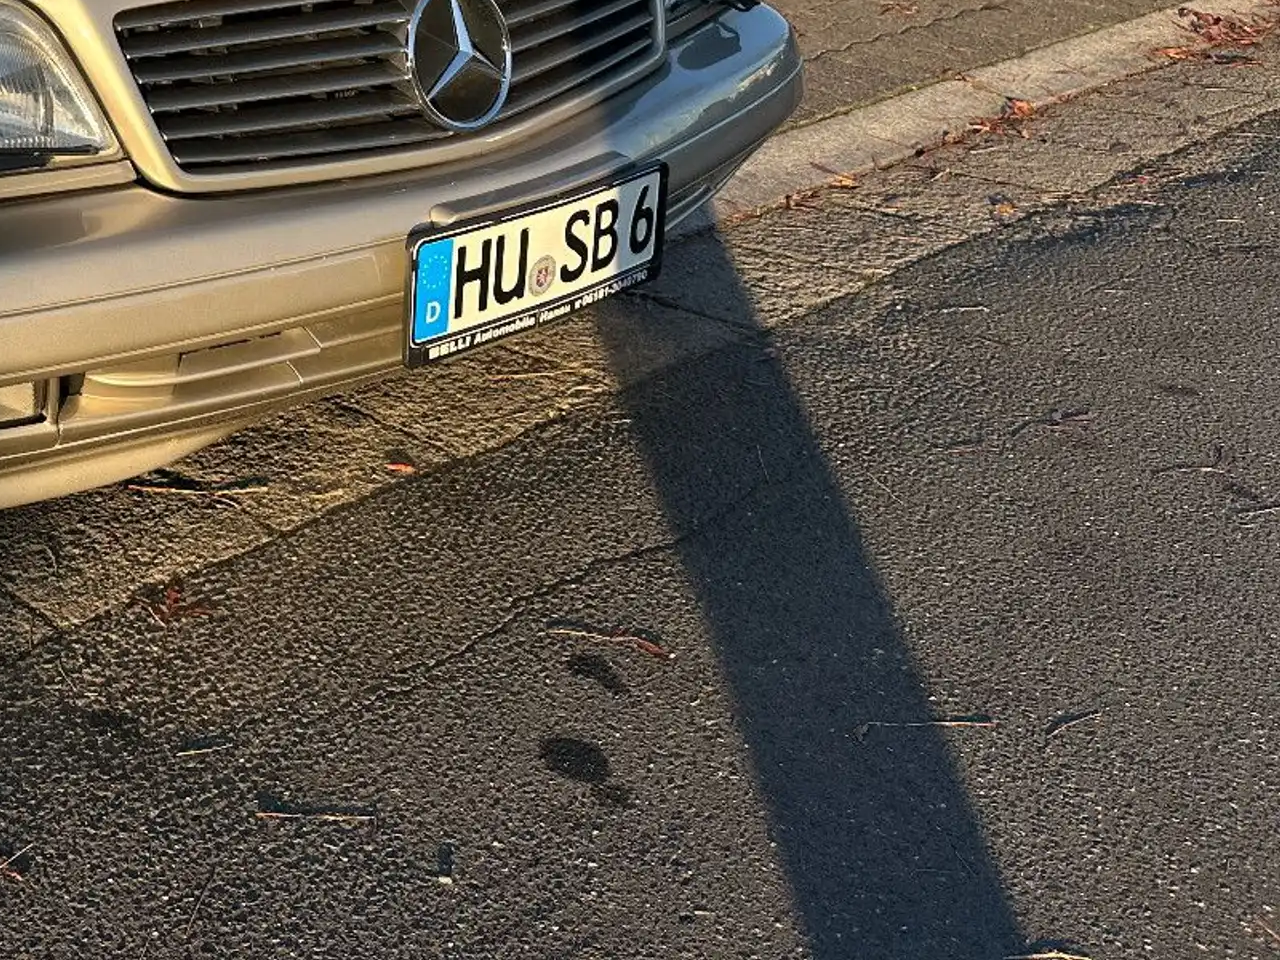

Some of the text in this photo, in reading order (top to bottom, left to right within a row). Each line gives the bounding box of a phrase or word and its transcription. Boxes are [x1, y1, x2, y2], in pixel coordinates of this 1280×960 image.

[454, 185, 654, 319] HU SB 6
[425, 301, 441, 325] D
[429, 339, 471, 359] BELLI
[473, 315, 536, 346] Automobile
